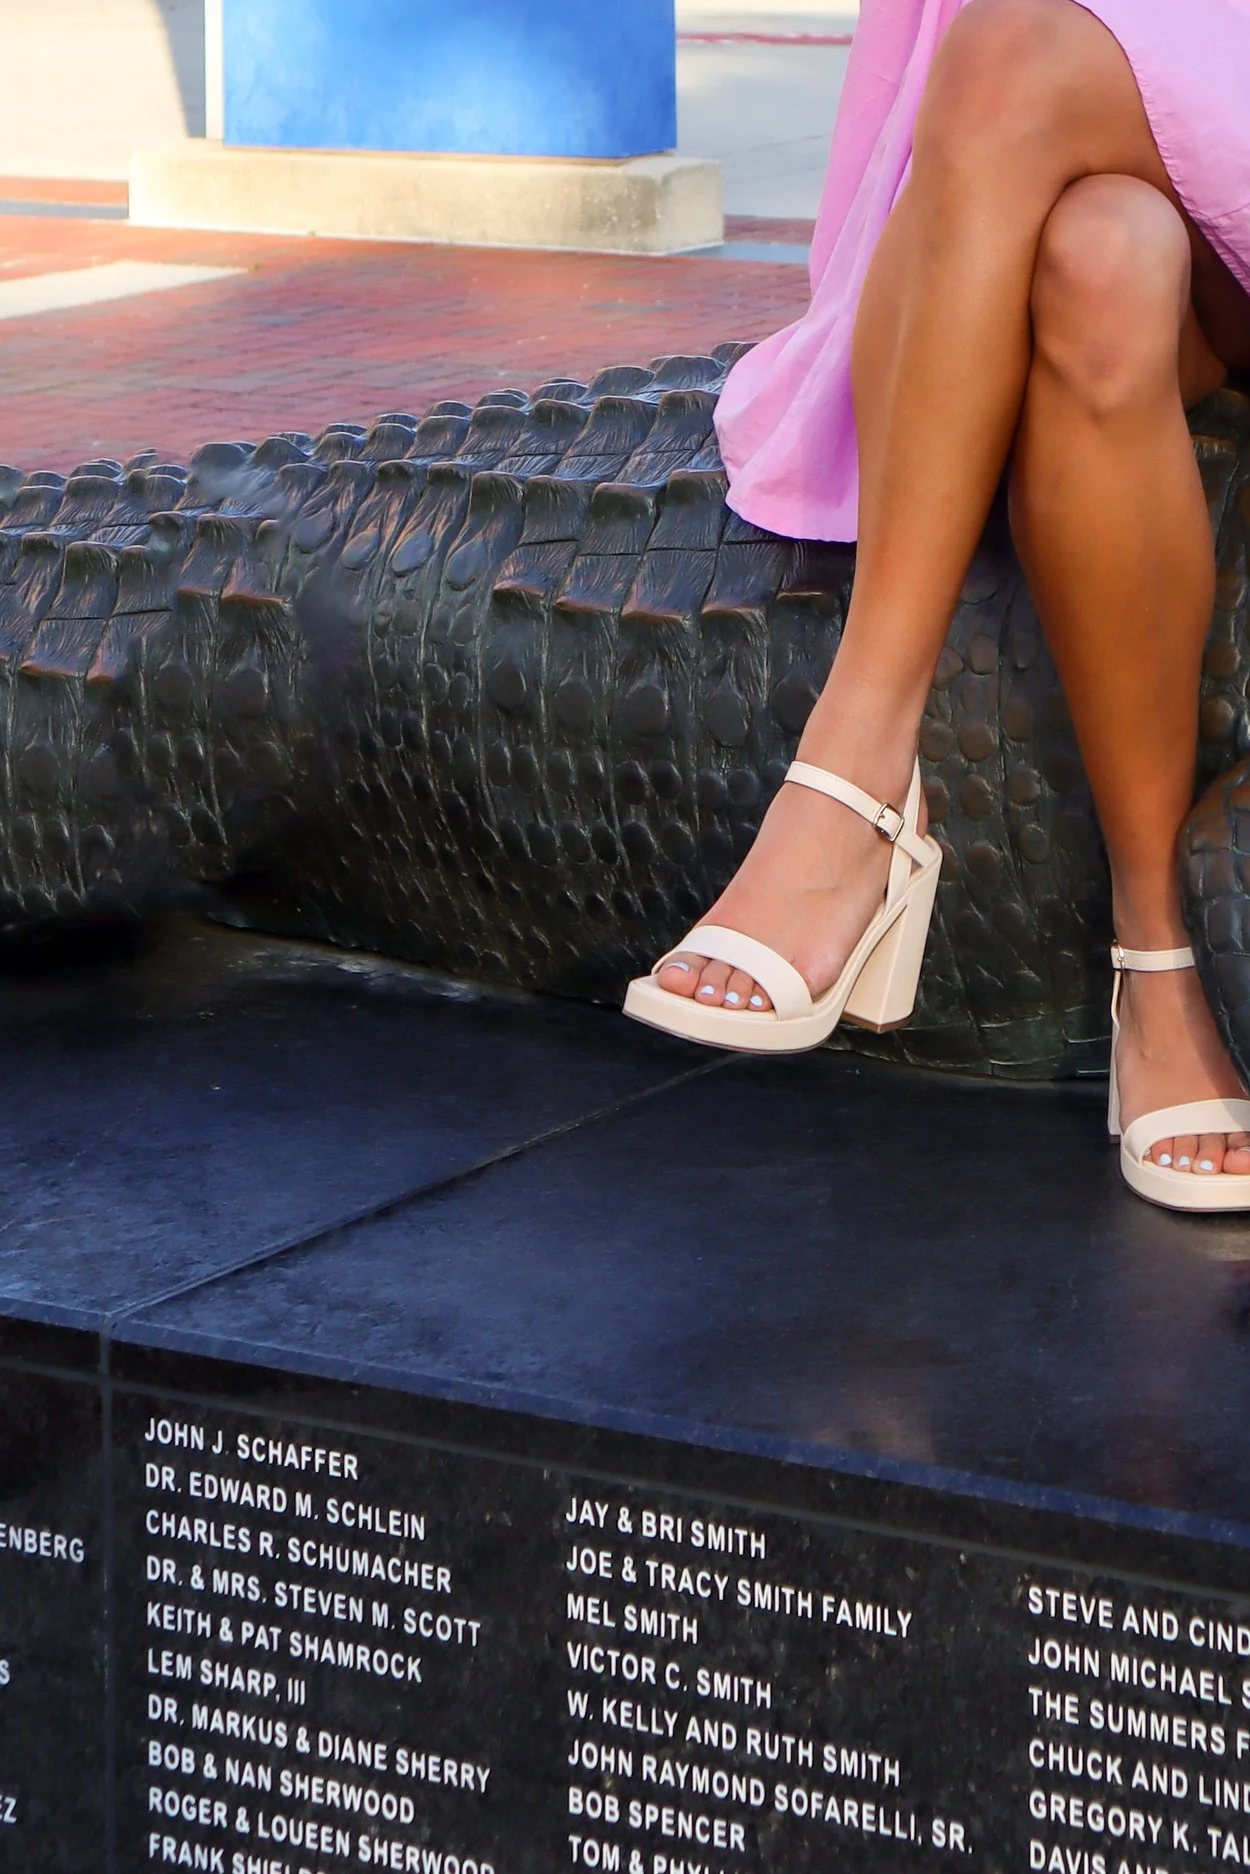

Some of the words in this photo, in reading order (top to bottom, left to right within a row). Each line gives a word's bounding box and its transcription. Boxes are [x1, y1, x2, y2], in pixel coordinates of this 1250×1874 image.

[145, 1418, 204, 1450] JOHN
[212, 1431, 229, 1455] J.
[237, 1434, 358, 1480] SCHAFFER
[146, 1463, 181, 1492] DR.
[190, 1471, 287, 1512] EDWARD
[296, 1492, 318, 1519] M.
[327, 1498, 424, 1540] SCHLEIN
[566, 1497, 608, 1528] JAY
[618, 1507, 632, 1533] &
[642, 1510, 682, 1543] BRI
[691, 1520, 765, 1559] SMITH
[146, 1510, 251, 1552] CHARLES
[260, 1531, 280, 1558] R.
[288, 1537, 451, 1593] SCHUMACHER
[147, 1555, 182, 1586] DR.
[191, 1565, 204, 1590] &
[213, 1569, 266, 1603] MRS.
[275, 1581, 363, 1622] STEVEN
[372, 1601, 395, 1629] M.
[404, 1608, 481, 1646] SCOTT
[567, 1546, 612, 1578] JOE
[622, 1556, 636, 1583] &
[646, 1560, 728, 1600] TRACY
[737, 1579, 812, 1618] SMITH
[823, 1595, 911, 1638] FAMILY
[568, 1593, 615, 1627] MEL
[624, 1604, 697, 1644] SMITH
[1028, 1585, 1113, 1629] STEVE
[1123, 1605, 1178, 1640] AND
[148, 1602, 211, 1638] KEITH
[219, 1617, 233, 1642] &
[242, 1621, 281, 1651] PAT
[290, 1631, 421, 1682] SHAMROCK
[567, 1641, 655, 1684] VICTOR
[665, 1662, 687, 1691] C.
[697, 1668, 771, 1709] SMITH
[1028, 1638, 1099, 1677] JOHN
[1111, 1652, 1232, 1705] MICHAEL
[148, 1648, 191, 1680] LEM
[200, 1659, 280, 1702] SHARP,
[288, 1678, 305, 1705] III
[148, 1694, 184, 1725] DR.
[192, 1704, 287, 1748] MARKUS
[296, 1726, 310, 1753] &
[319, 1731, 387, 1770] DIANE
[396, 1748, 490, 1793] SHERRY
[568, 1690, 593, 1720] W.
[603, 1698, 678, 1737] KELLY
[686, 1716, 736, 1750] AND
[747, 1728, 812, 1767] RUTH
[823, 1744, 899, 1786] SMITH
[1029, 1686, 1079, 1724] THE
[1090, 1699, 1225, 1755] SUMMERS
[149, 1740, 195, 1774] BOB
[203, 1753, 217, 1779] &
[226, 1758, 271, 1791] NAN
[280, 1770, 414, 1824] SHERWOOD
[568, 1739, 632, 1777] JOHN
[643, 1754, 765, 1806] RAYMOND
[775, 1784, 921, 1845] SOFARELLI,
[932, 1818, 972, 1853] SR.
[1029, 1738, 1122, 1785] CHUCK
[1132, 1760, 1188, 1798] AND
[149, 1787, 227, 1828] ROGER
[235, 1807, 250, 1833] &
[258, 1812, 349, 1857] LOUEEN
[569, 1786, 619, 1822] BOB
[629, 1800, 745, 1852] SPENCER
[1030, 1789, 1162, 1844] GREGORY
[1173, 1820, 1196, 1853] K.
[149, 1832, 224, 1874] FRANK
[569, 1835, 619, 1872] TOM
[629, 1849, 643, 1874] &
[1030, 1839, 1106, 1874] DAVIS
